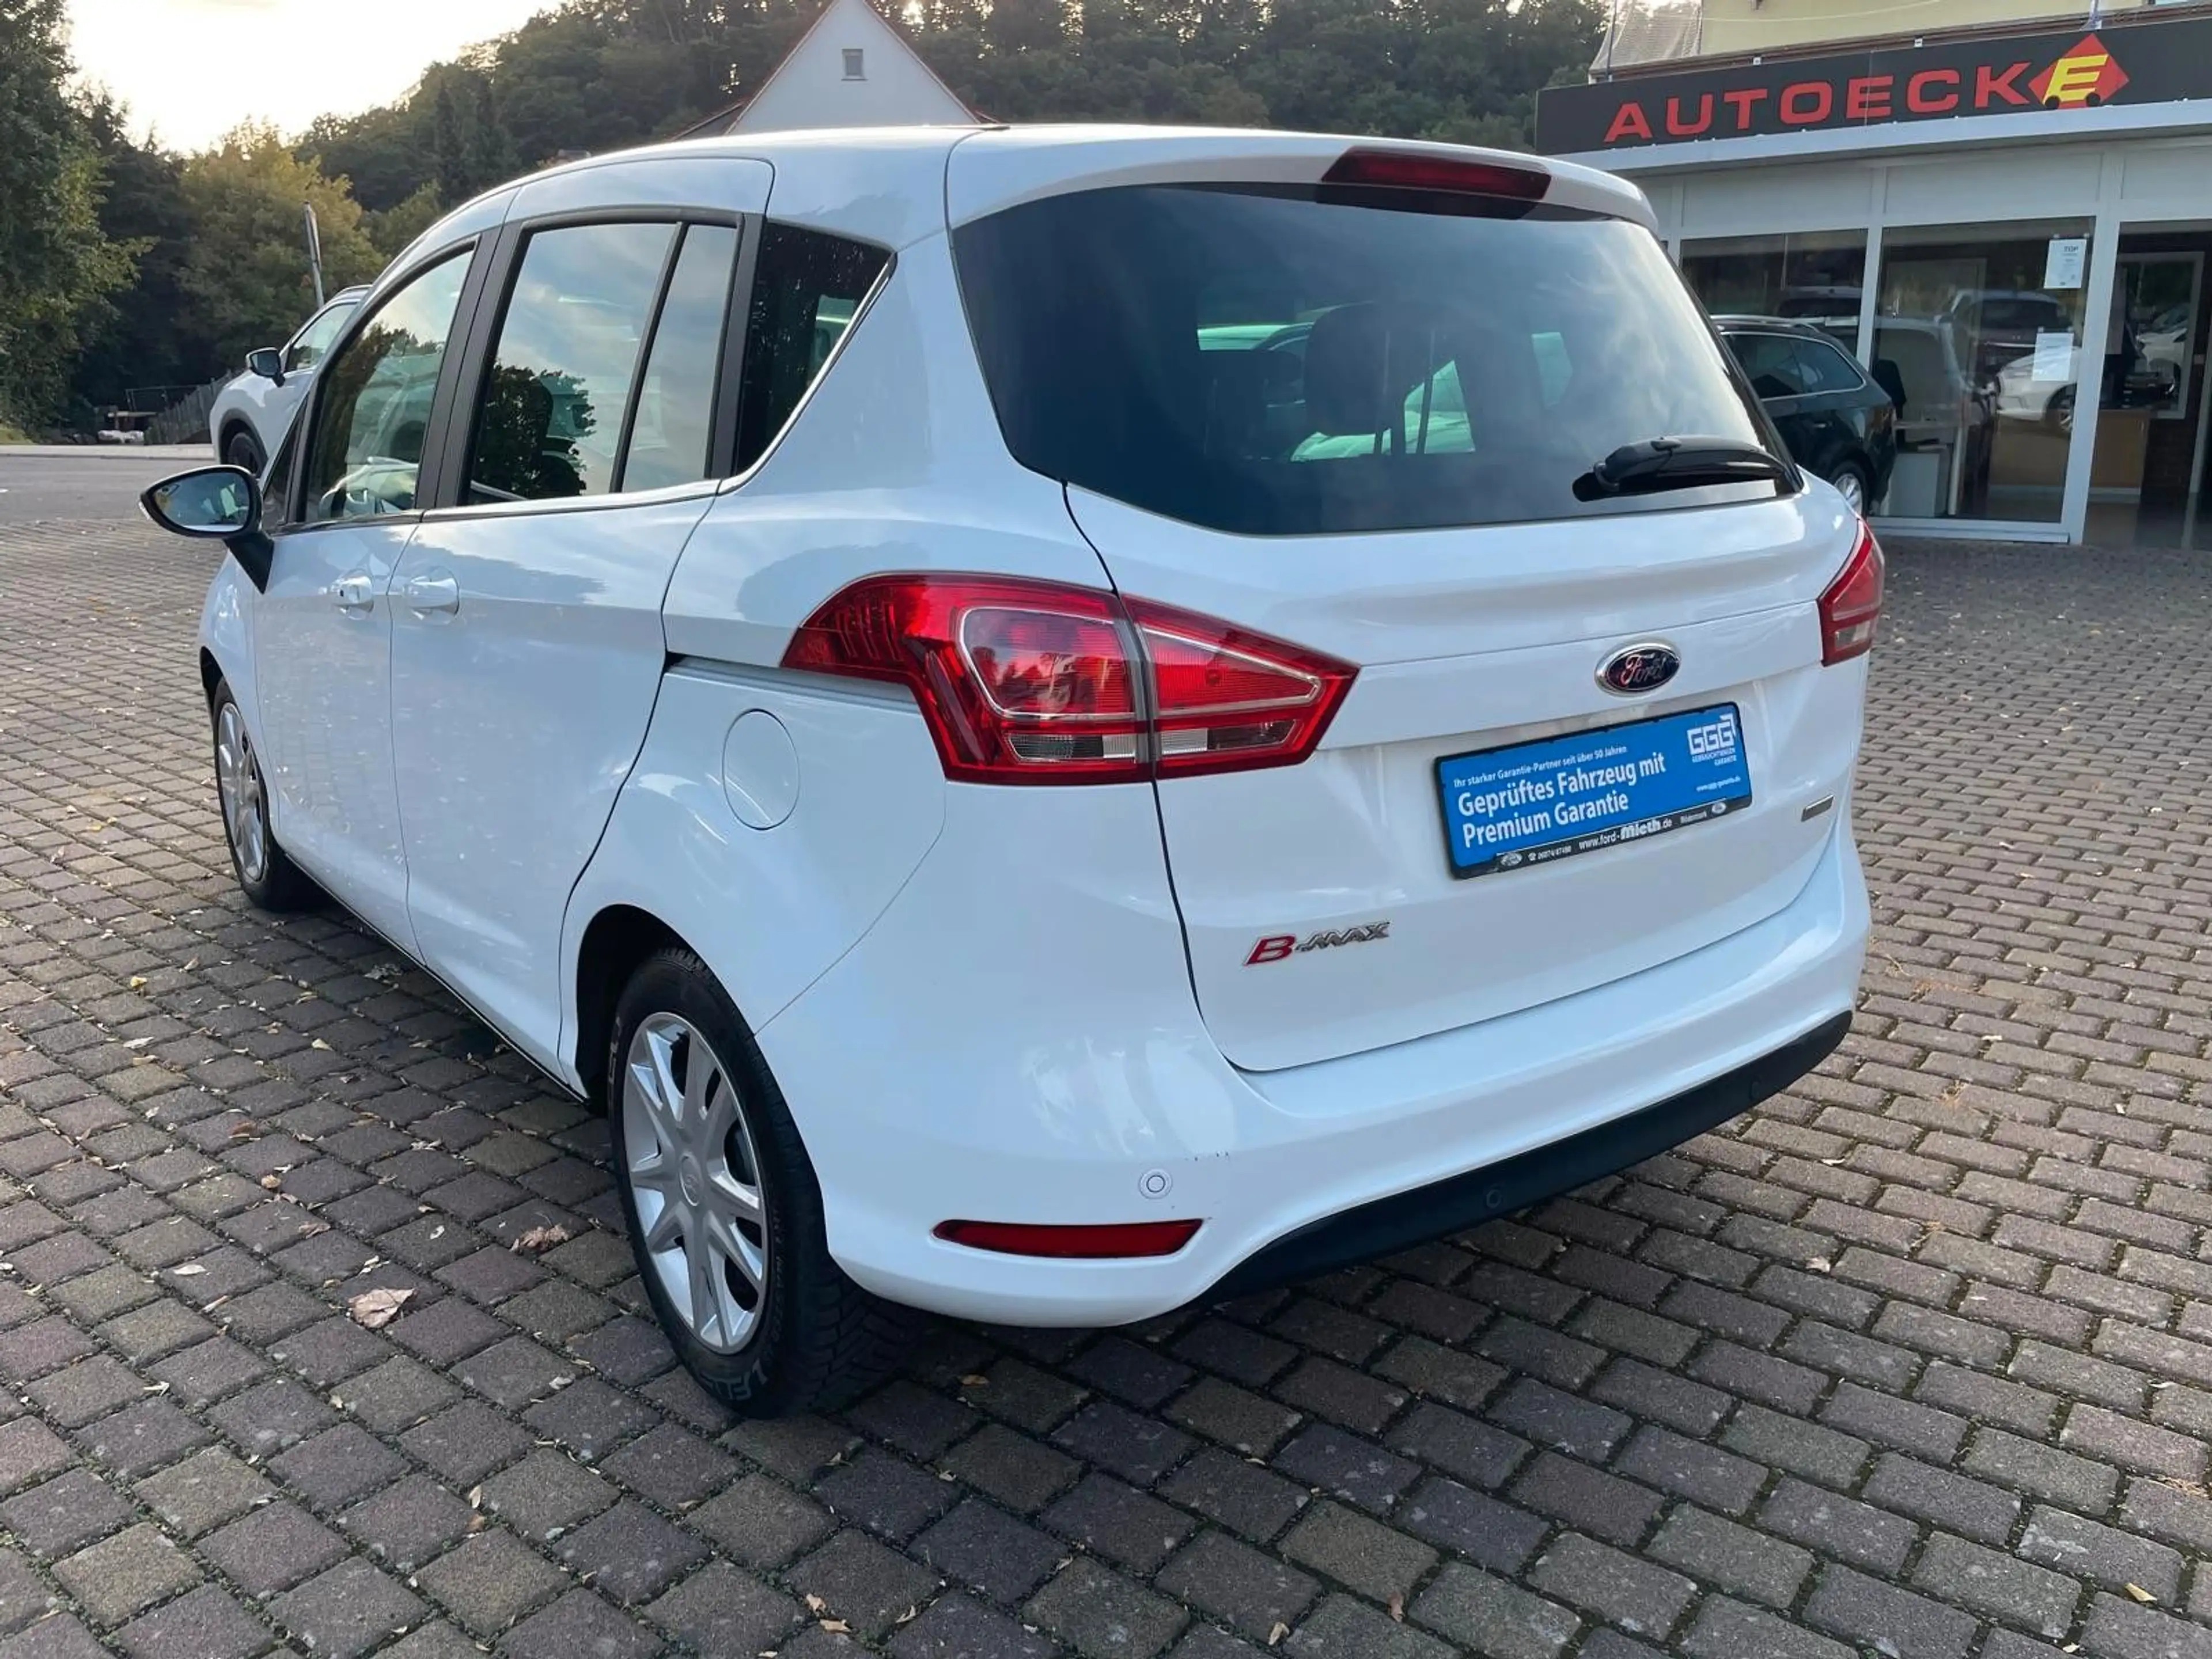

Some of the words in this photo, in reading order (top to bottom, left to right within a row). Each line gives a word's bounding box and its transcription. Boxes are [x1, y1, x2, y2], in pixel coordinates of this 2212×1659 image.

[1620, 653, 1667, 685] Ford
[1687, 721, 1735, 756] GGG
[1454, 778, 1465, 788] Ihr
[1468, 772, 1496, 786] starker
[1497, 759, 1561, 780] Garantie-Partner
[1562, 755, 1577, 767] seit
[1577, 752, 1593, 763] über
[1605, 745, 1627, 757] Jahren
[1459, 779, 1555, 818] Geprüftes
[1557, 767, 1637, 796] Fahrzeug
[1639, 752, 1666, 777] mit
[1463, 812, 1551, 848] Premium
[1555, 790, 1629, 825] Garantie
[1242, 921, 1390, 967] B-MAX
